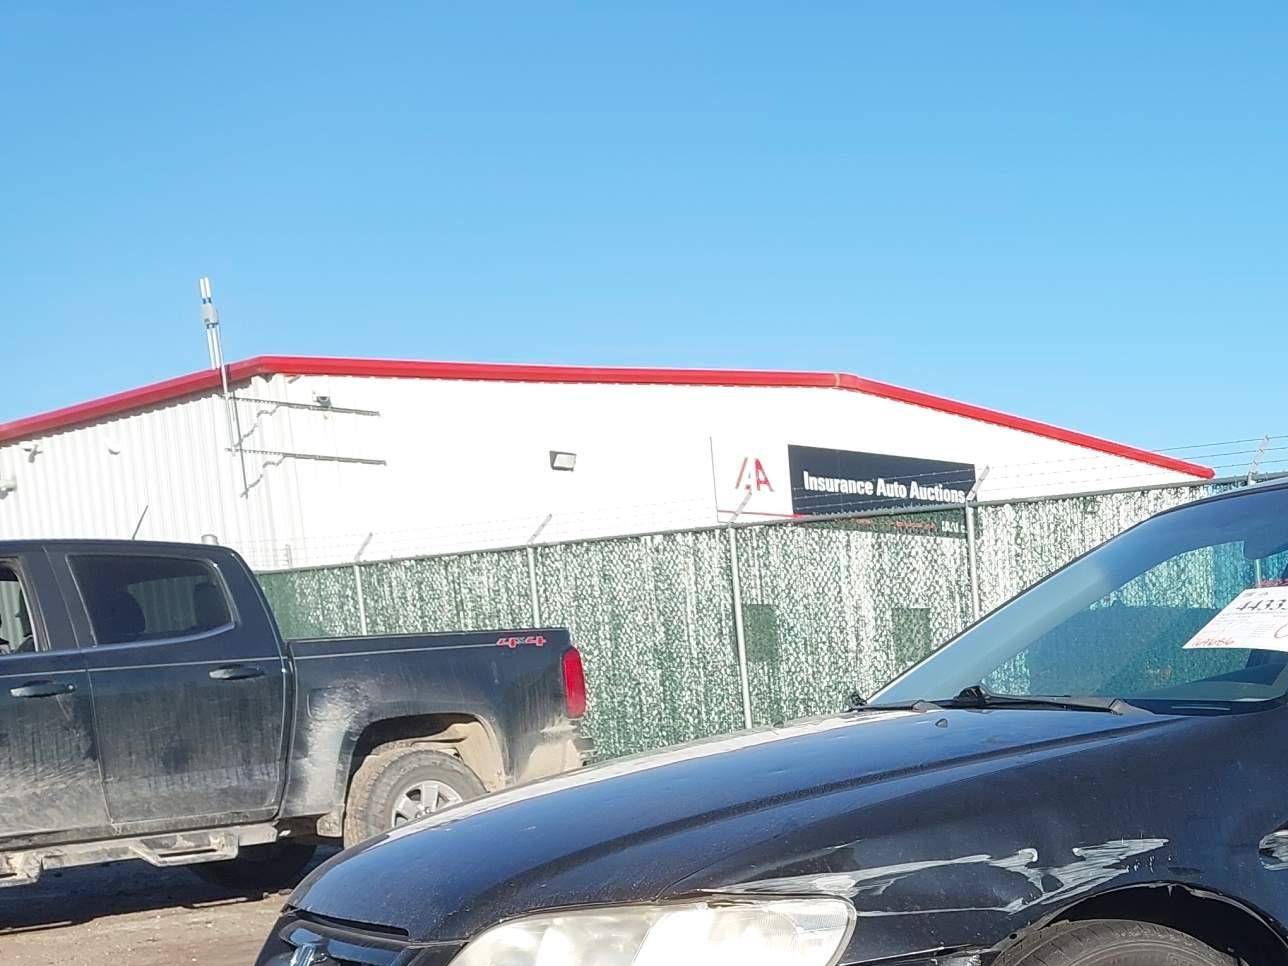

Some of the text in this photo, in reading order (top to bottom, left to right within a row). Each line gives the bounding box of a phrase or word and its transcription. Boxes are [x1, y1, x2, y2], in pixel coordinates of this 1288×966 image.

[802, 470, 967, 504] Insurance Auto Auctions
